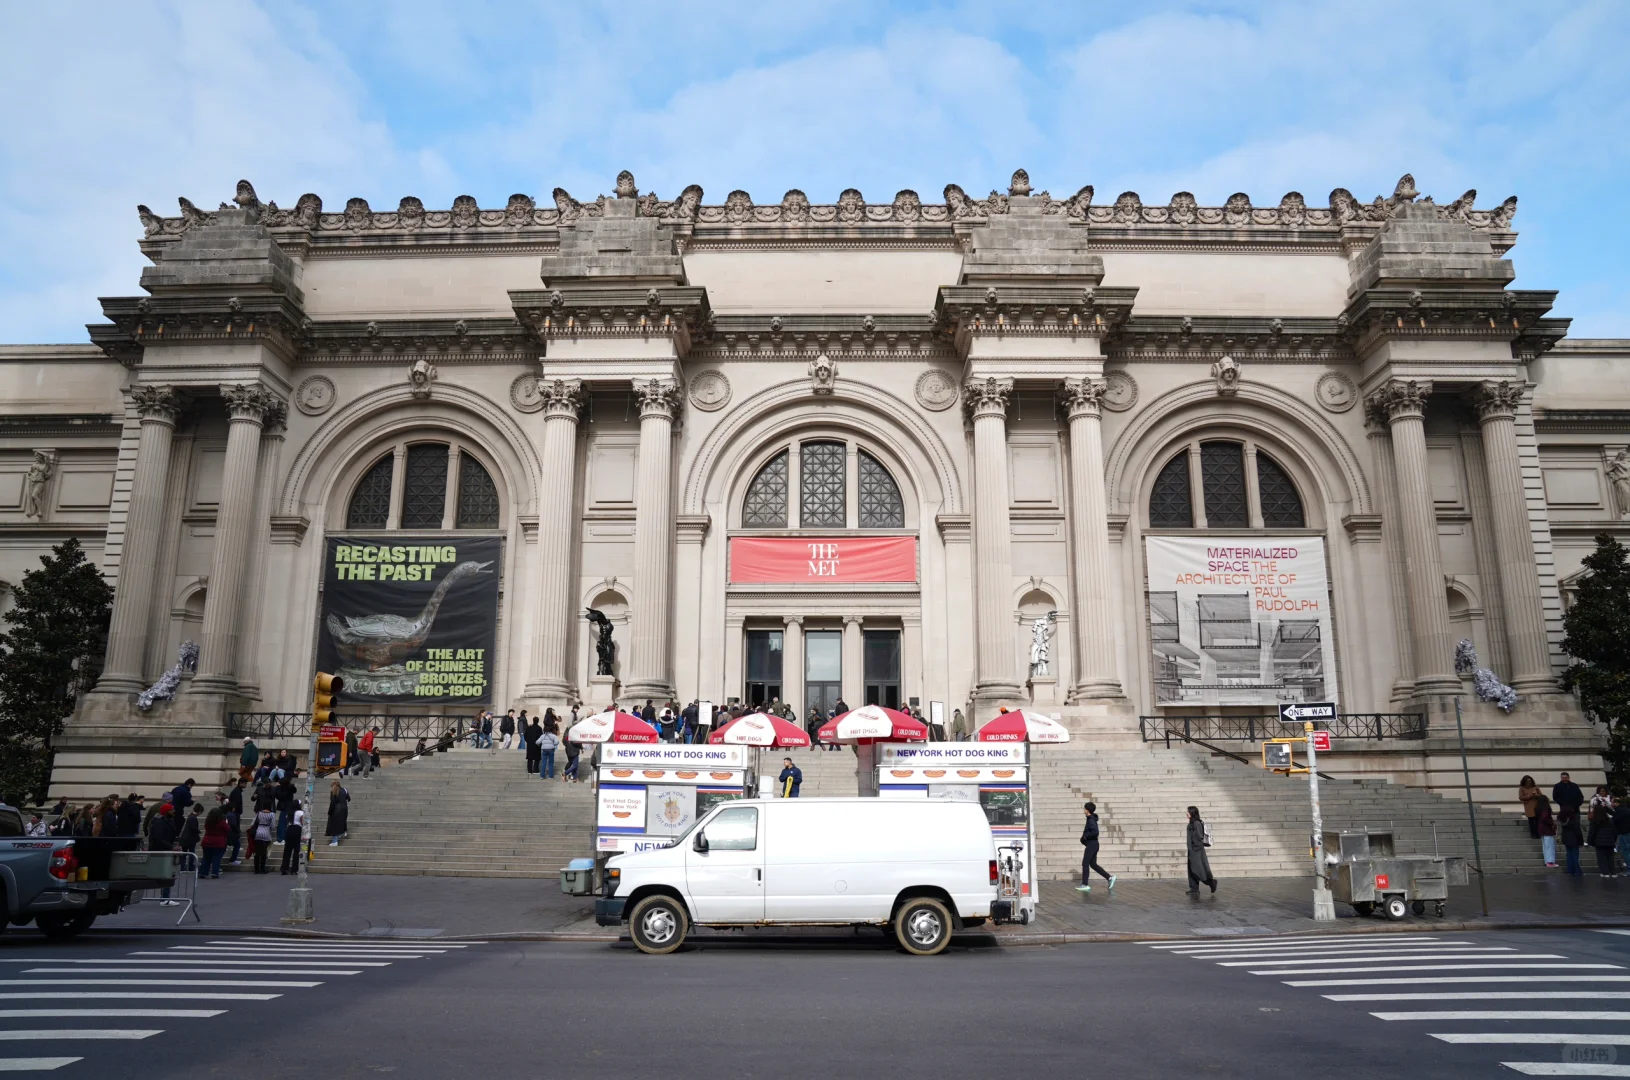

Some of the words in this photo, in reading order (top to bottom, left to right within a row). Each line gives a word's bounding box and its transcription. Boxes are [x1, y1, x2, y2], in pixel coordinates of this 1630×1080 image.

[335, 546, 456, 562] RECASTING
[808, 543, 839, 559] THE
[1207, 548, 1298, 559] MATERIALIZED
[808, 560, 840, 576] MET
[1208, 561, 1250, 572] SPACE
[1251, 561, 1278, 572] THE
[335, 564, 376, 580] THE
[379, 564, 436, 581] PAST
[1176, 574, 1274, 584] ARCHITECTURE
[1278, 574, 1297, 584] OF
[1255, 587, 1287, 598] PAUL
[1256, 600, 1318, 611] RUDOLPH
[427, 648, 453, 659] THE
[456, 648, 485, 659] ART
[406, 661, 424, 672] OF
[425, 661, 484, 672] CHINESE
[419, 673, 487, 686] BRONZES,
[414, 685, 482, 696] 1100-1900
[658, 791, 670, 799] NEW
[672, 791, 686, 799] YORK
[656, 814, 665, 824] HOT
[677, 814, 688, 826] KING
